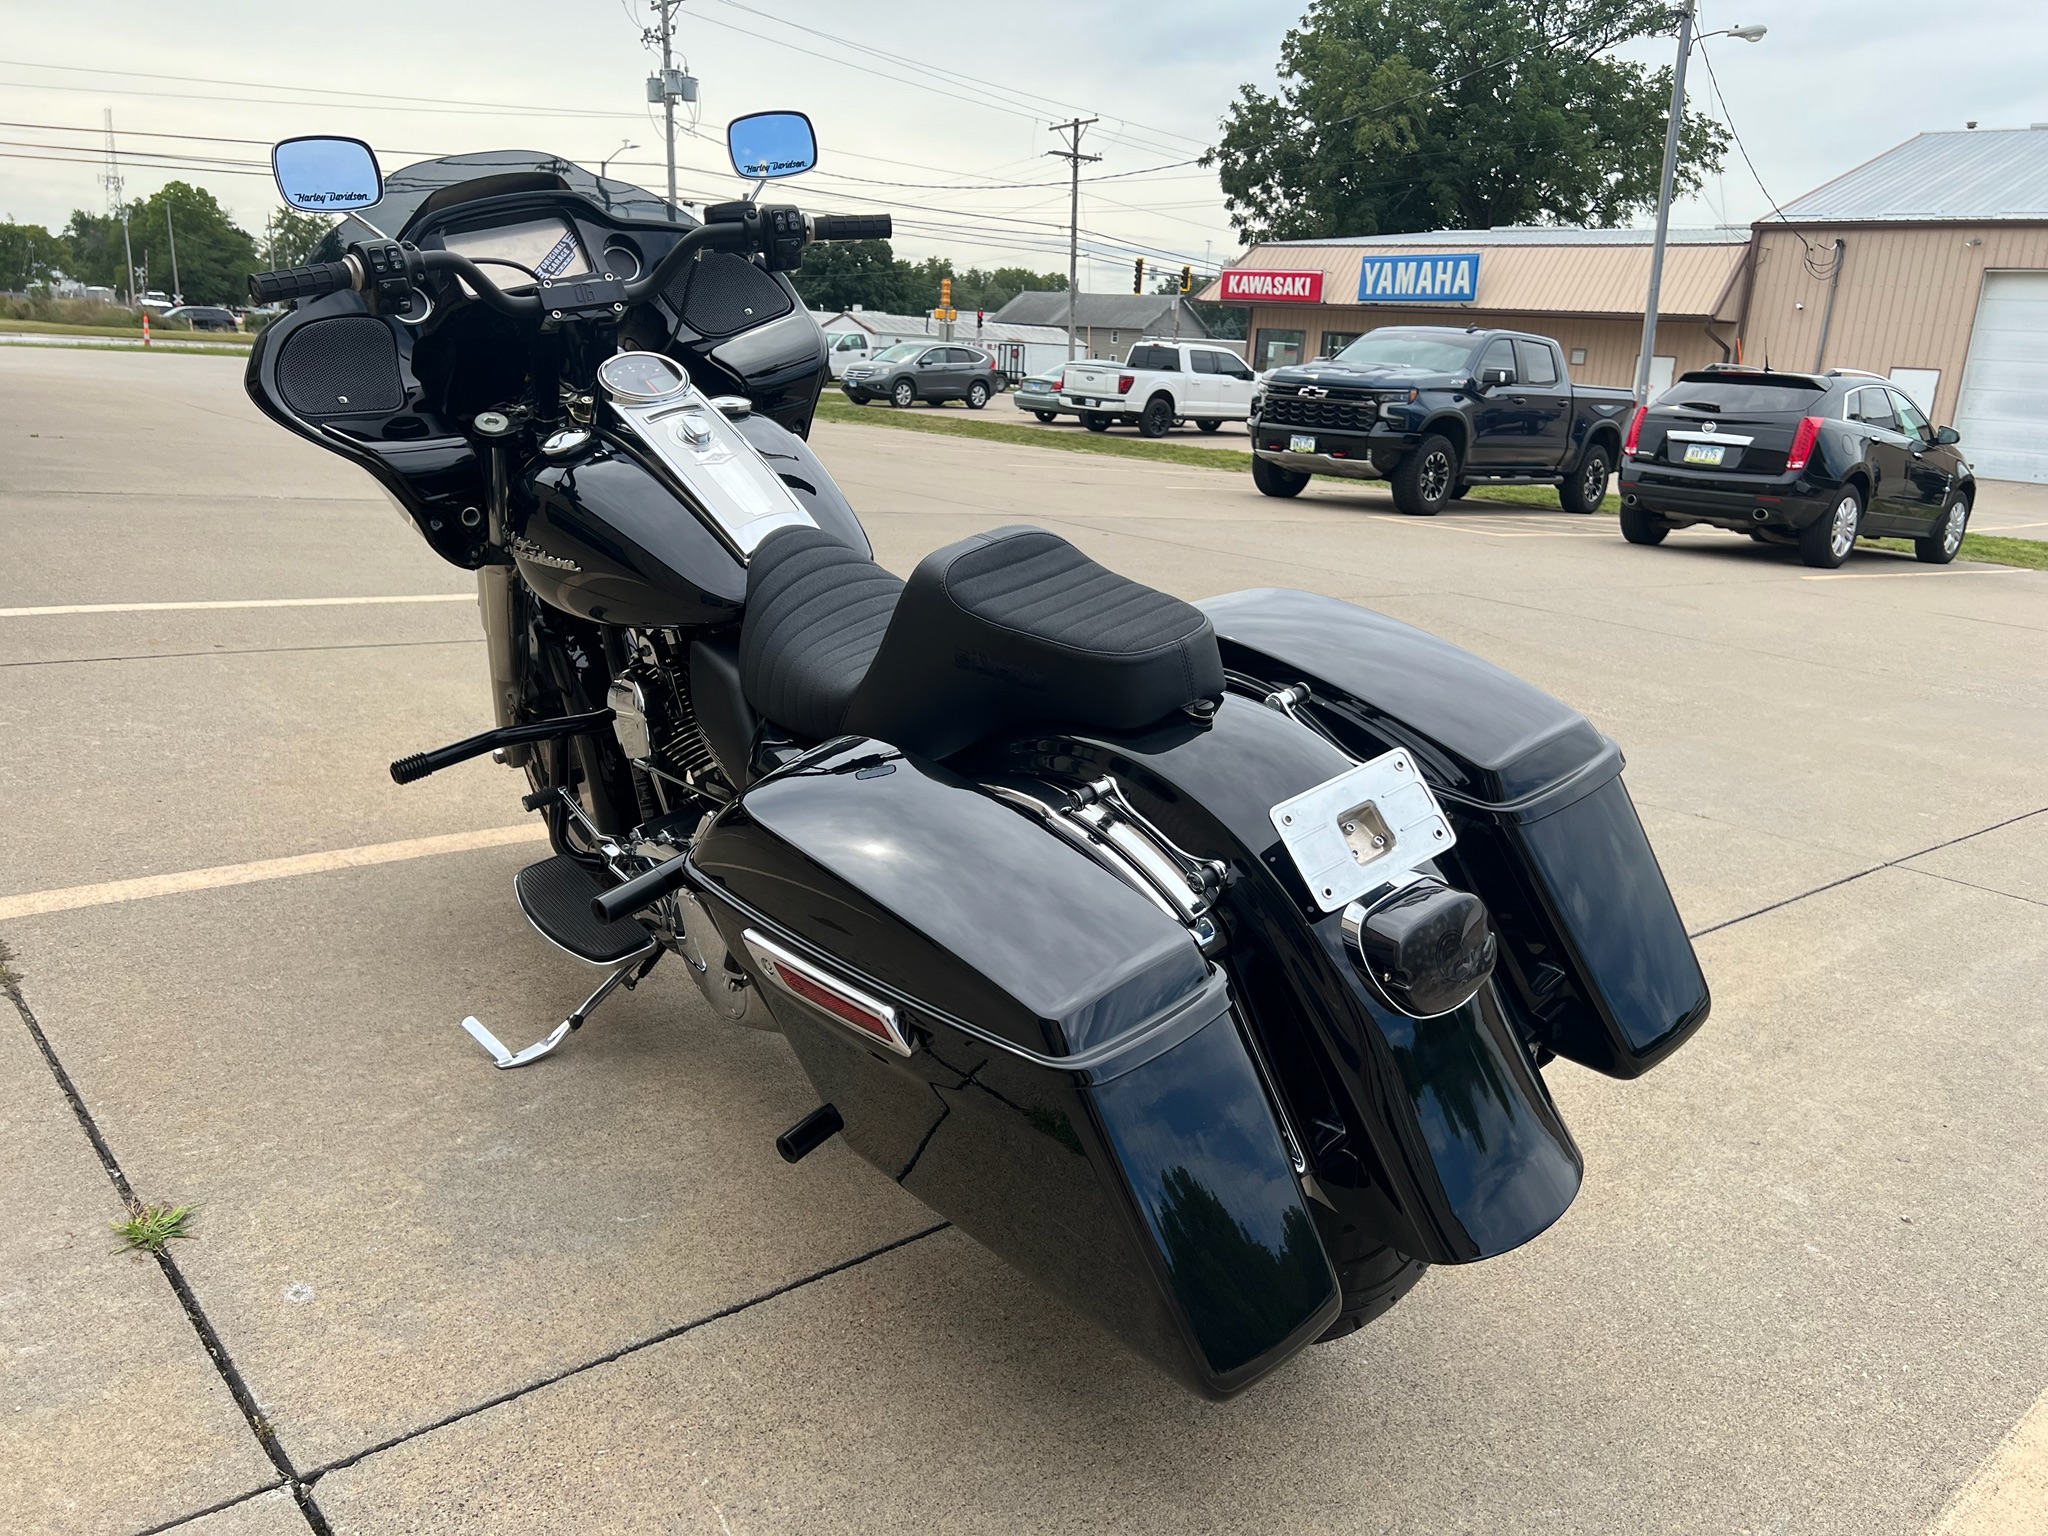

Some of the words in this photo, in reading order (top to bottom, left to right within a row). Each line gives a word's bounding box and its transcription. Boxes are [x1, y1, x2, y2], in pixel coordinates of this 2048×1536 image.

[744, 163, 770, 173] Harley
[770, 160, 807, 170] Davidson
[294, 193, 326, 204] Harley
[325, 191, 371, 201] Davidson
[540, 242, 566, 269] ORIGINAL
[547, 248, 570, 272] GARAGE
[1228, 275, 1311, 297] KAWASAKI
[1364, 260, 1471, 295] YAMAHA
